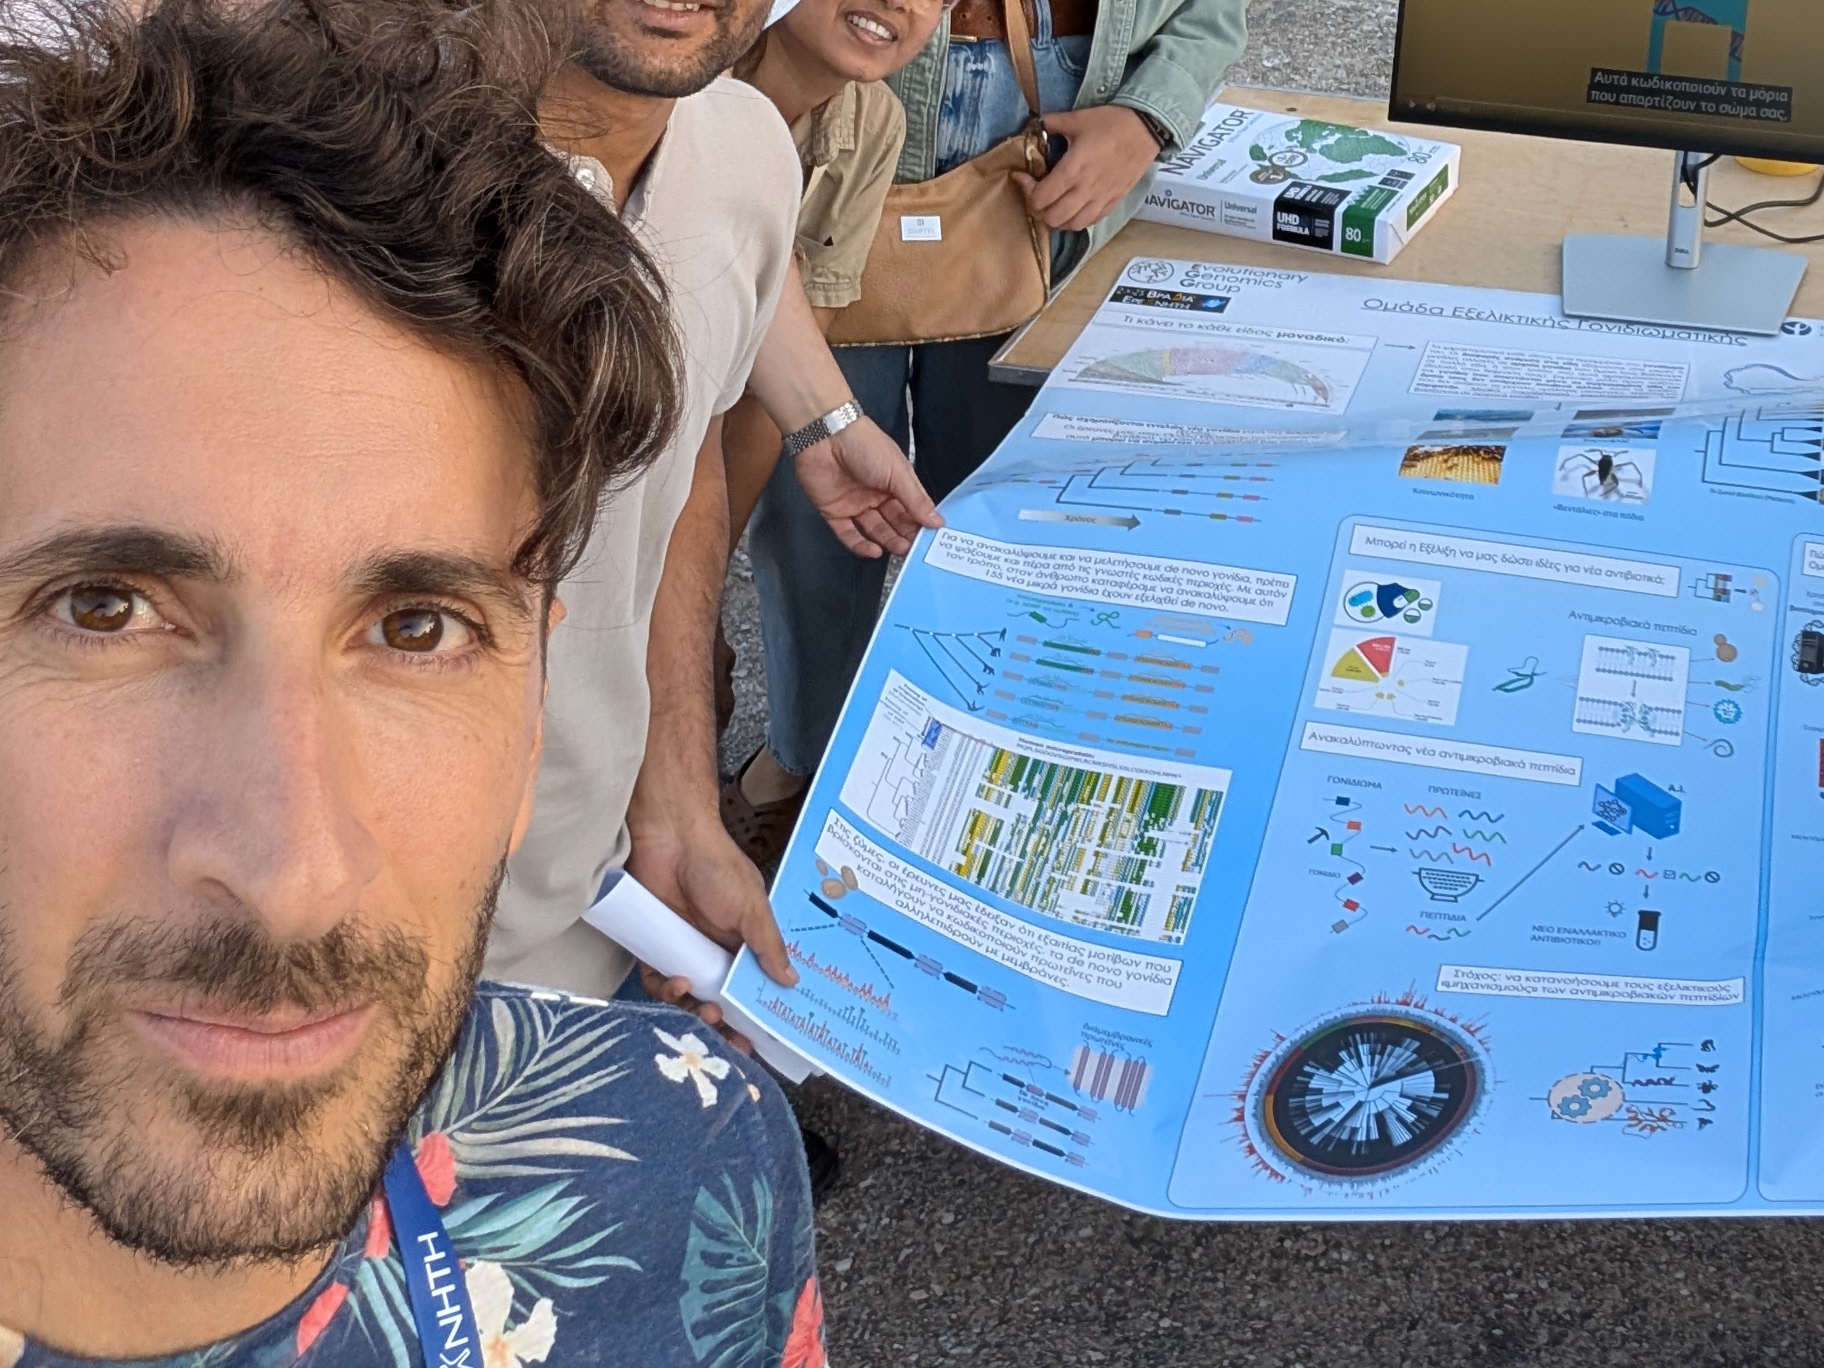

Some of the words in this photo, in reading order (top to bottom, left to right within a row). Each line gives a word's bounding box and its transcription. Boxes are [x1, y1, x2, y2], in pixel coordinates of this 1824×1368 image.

[1594, 71, 1628, 86] Αυτά
[1631, 76, 1727, 96] κωδικοποιούν
[1731, 88, 1746, 97] τα
[1750, 88, 1789, 103] μόρια
[1590, 90, 1617, 101] που
[1619, 94, 1698, 111] απαρτίζουν
[1700, 101, 1716, 112] το
[1719, 102, 1757, 118] σώμα
[1158, 109, 1254, 176] NAVIGATOR
[1224, 201, 1257, 213] Universal
[1277, 211, 1300, 225] UHD
[1345, 227, 1361, 242] 80
[1179, 278, 1241, 294] Group
[1184, 270, 1283, 289] Genomics
[1191, 263, 1308, 283] Evolutionary
[1137, 316, 1174, 327] κάνει
[1178, 321, 1194, 329] το
[1199, 322, 1232, 332] κάθε
[1236, 327, 1273, 337] είδος
[1363, 298, 1444, 316] Ομάδα
[1452, 306, 1571, 330] Εξελικτικής
[1578, 320, 1747, 346] Γονιδιωματικής
[941, 532, 957, 542] Για
[961, 537, 973, 546] να
[977, 542, 1056, 561] ανακαλύψουμε
[1059, 553, 1075, 561] και
[1078, 555, 1092, 563] να
[1094, 556, 1161, 573] μελετήσουμε
[1164, 562, 1179, 572] de
[1182, 567, 1209, 578] novo
[1365, 536, 1407, 550] Μπορεί
[1410, 543, 1416, 552] η
[1419, 542, 1457, 558] Εξέλιξη
[1460, 549, 1474, 558] να
[1476, 552, 1499, 564] μας
[1500, 552, 1533, 567] δώσει
[1535, 558, 1562, 572] ιδέες
[1564, 563, 1581, 574] για
[1584, 565, 1602, 576] νέα
[939, 541, 951, 550] να
[955, 544, 1001, 563] ψάξουμε
[1004, 557, 1020, 566] και
[1023, 559, 1050, 570] πέρα
[1052, 561, 1076, 572] από
[1078, 565, 1091, 575] τις
[1094, 568, 1139, 581] γνωστές
[1142, 574, 1183, 587] κωδικές
[1237, 584, 1252, 594] Με
[1254, 587, 1287, 599] αυτόν
[946, 551, 964, 561] τον
[1006, 567, 1033, 577] στον
[1036, 570, 1089, 584] άνθρωπο
[1092, 577, 1156, 594] καταφέραμε
[1160, 586, 1174, 594] να
[1176, 587, 1256, 606] ανακαλύψουμε
[1260, 598, 1274, 607] ότι
[985, 569, 1003, 580] 155
[1006, 574, 1025, 585] νέα
[1027, 580, 1057, 590] μικρά
[1060, 583, 1100, 596] γονίδια
[1102, 588, 1133, 600] έχουν
[1135, 594, 1178, 607] εξελιχθεί
[1181, 599, 1195, 608] de
[1568, 610, 1651, 630] Αντιμικροβιακά
[1654, 623, 1698, 636] πεπτίδια
[1309, 731, 1412, 755] Ανακαλύπτωντας
[1416, 746, 1436, 757] νέα
[1439, 750, 1526, 769] αντιμικροβιακά
[1529, 762, 1575, 775] πεπτίδια
[1327, 775, 1382, 790] ΓΟΝΙΔΙΩΜΑ
[826, 824, 882, 873] βρίσκονται
[885, 869, 909, 888] στις
[909, 884, 988, 930] μη-γονιδιακές
[1049, 951, 1064, 961] τα
[1067, 955, 1084, 968] de
[1087, 962, 1123, 976] novo
[1125, 969, 1172, 986] γονίδια
[833, 816, 852, 839] Στις
[889, 860, 900, 870] οι
[901, 864, 948, 897] έρευνες
[948, 892, 973, 911] μας
[975, 904, 1015, 930] έδειξαν
[1018, 926, 1036, 938] ότι
[1037, 932, 1086, 957] εξαιτίας
[1087, 950, 1141, 969] μοτίβων
[1145, 961, 1172, 974] που
[857, 864, 927, 906] καταλήγουν
[929, 903, 945, 917] να
[946, 911, 1028, 956] κωδικοποιούν
[1096, 975, 1123, 989] που
[895, 899, 983, 948] αλληλεπιδρούν
[985, 945, 1000, 956] με
[1420, 911, 1467, 922] ΠΕΠΤΙΔΙΑ
[1531, 924, 1555, 934] ΝΕΟ
[1557, 926, 1627, 939] ΕΝΑΛΛΑΚΤΙΚΟ
[1453, 969, 1501, 982] Στόχος:
[1505, 975, 1522, 983] να
[1525, 975, 1619, 989] κατανοήσουμε
[1624, 981, 1654, 991] τους
[1658, 983, 1731, 993] εξελικτικούς
[1542, 986, 1566, 995] των
[1569, 987, 1676, 1000] αντιμικροβιακών
[1680, 992, 1740, 1002] πεπτιδίων
